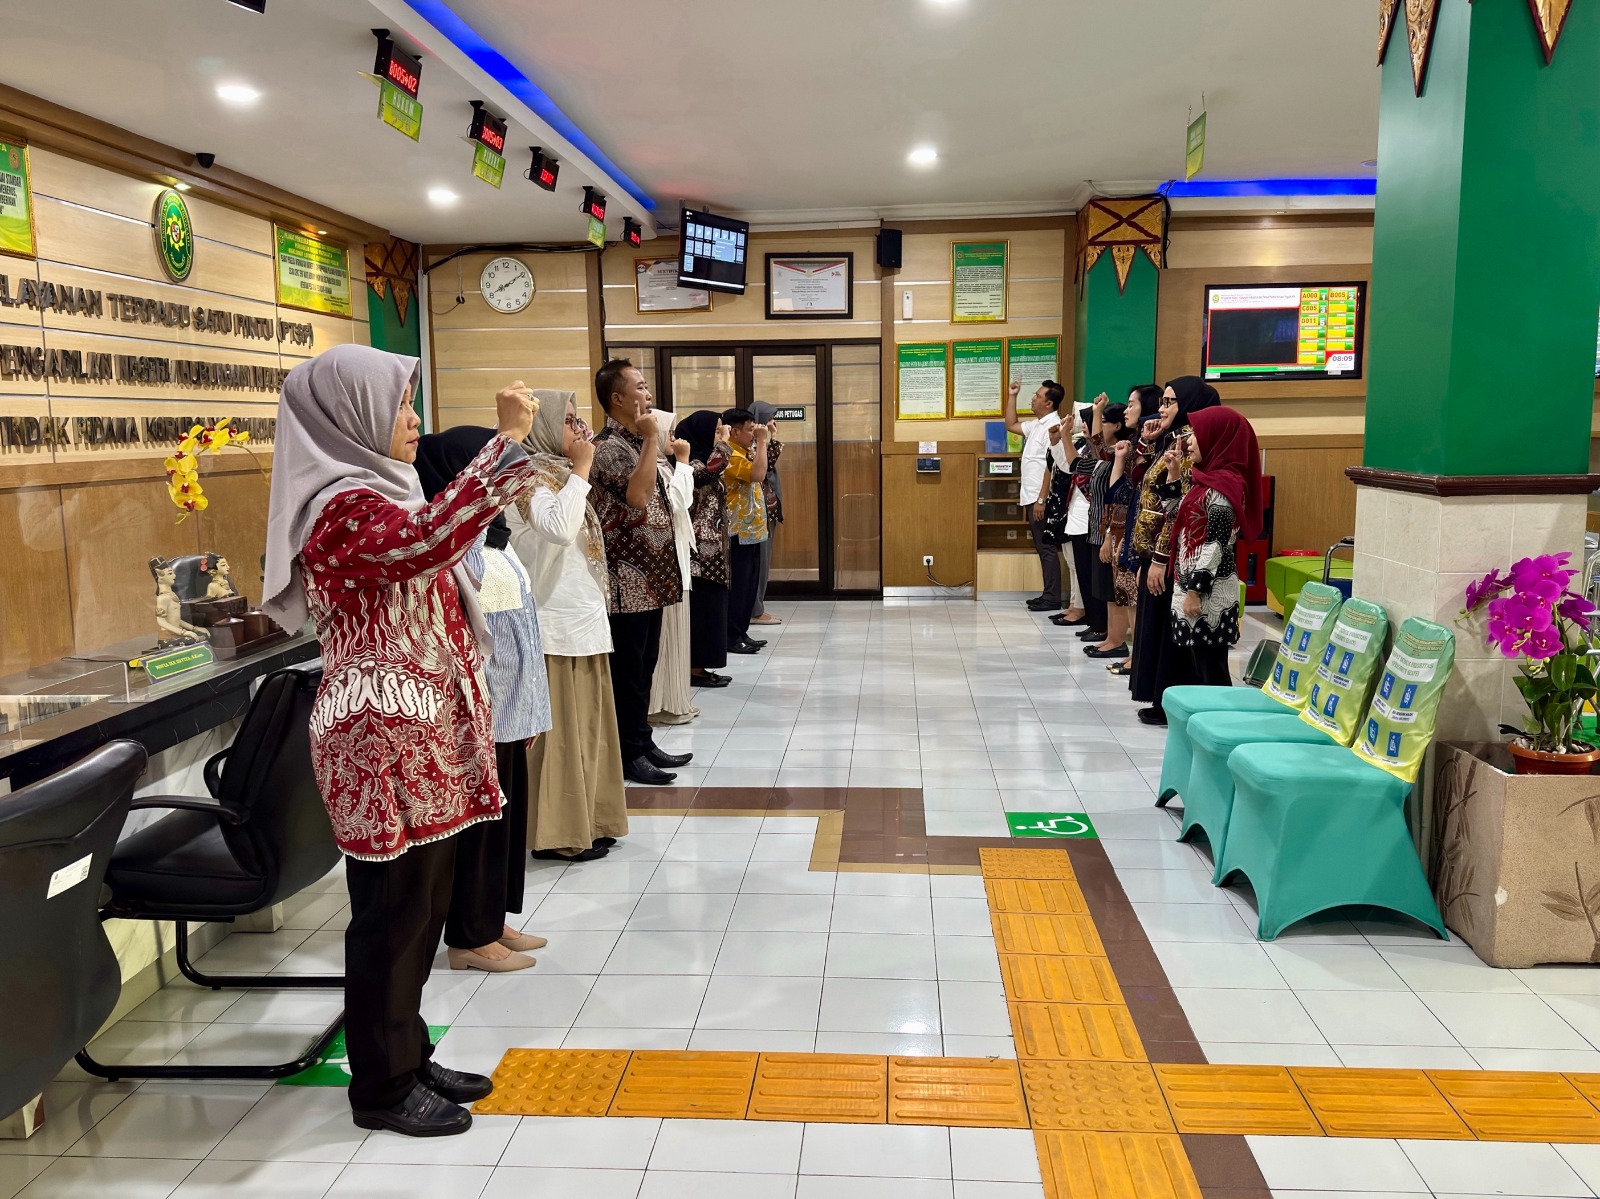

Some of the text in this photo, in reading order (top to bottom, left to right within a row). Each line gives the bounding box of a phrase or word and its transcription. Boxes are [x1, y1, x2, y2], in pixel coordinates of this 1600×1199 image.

[502, 261, 510, 269] 12
[106, 293, 190, 329] TERPADU
[192, 306, 232, 335] SATU
[233, 313, 274, 342] PINTU
[276, 317, 314, 350] (PTSP)
[784, 410, 803, 418] PETUGAS
[72, 416, 140, 443] PIDANA
